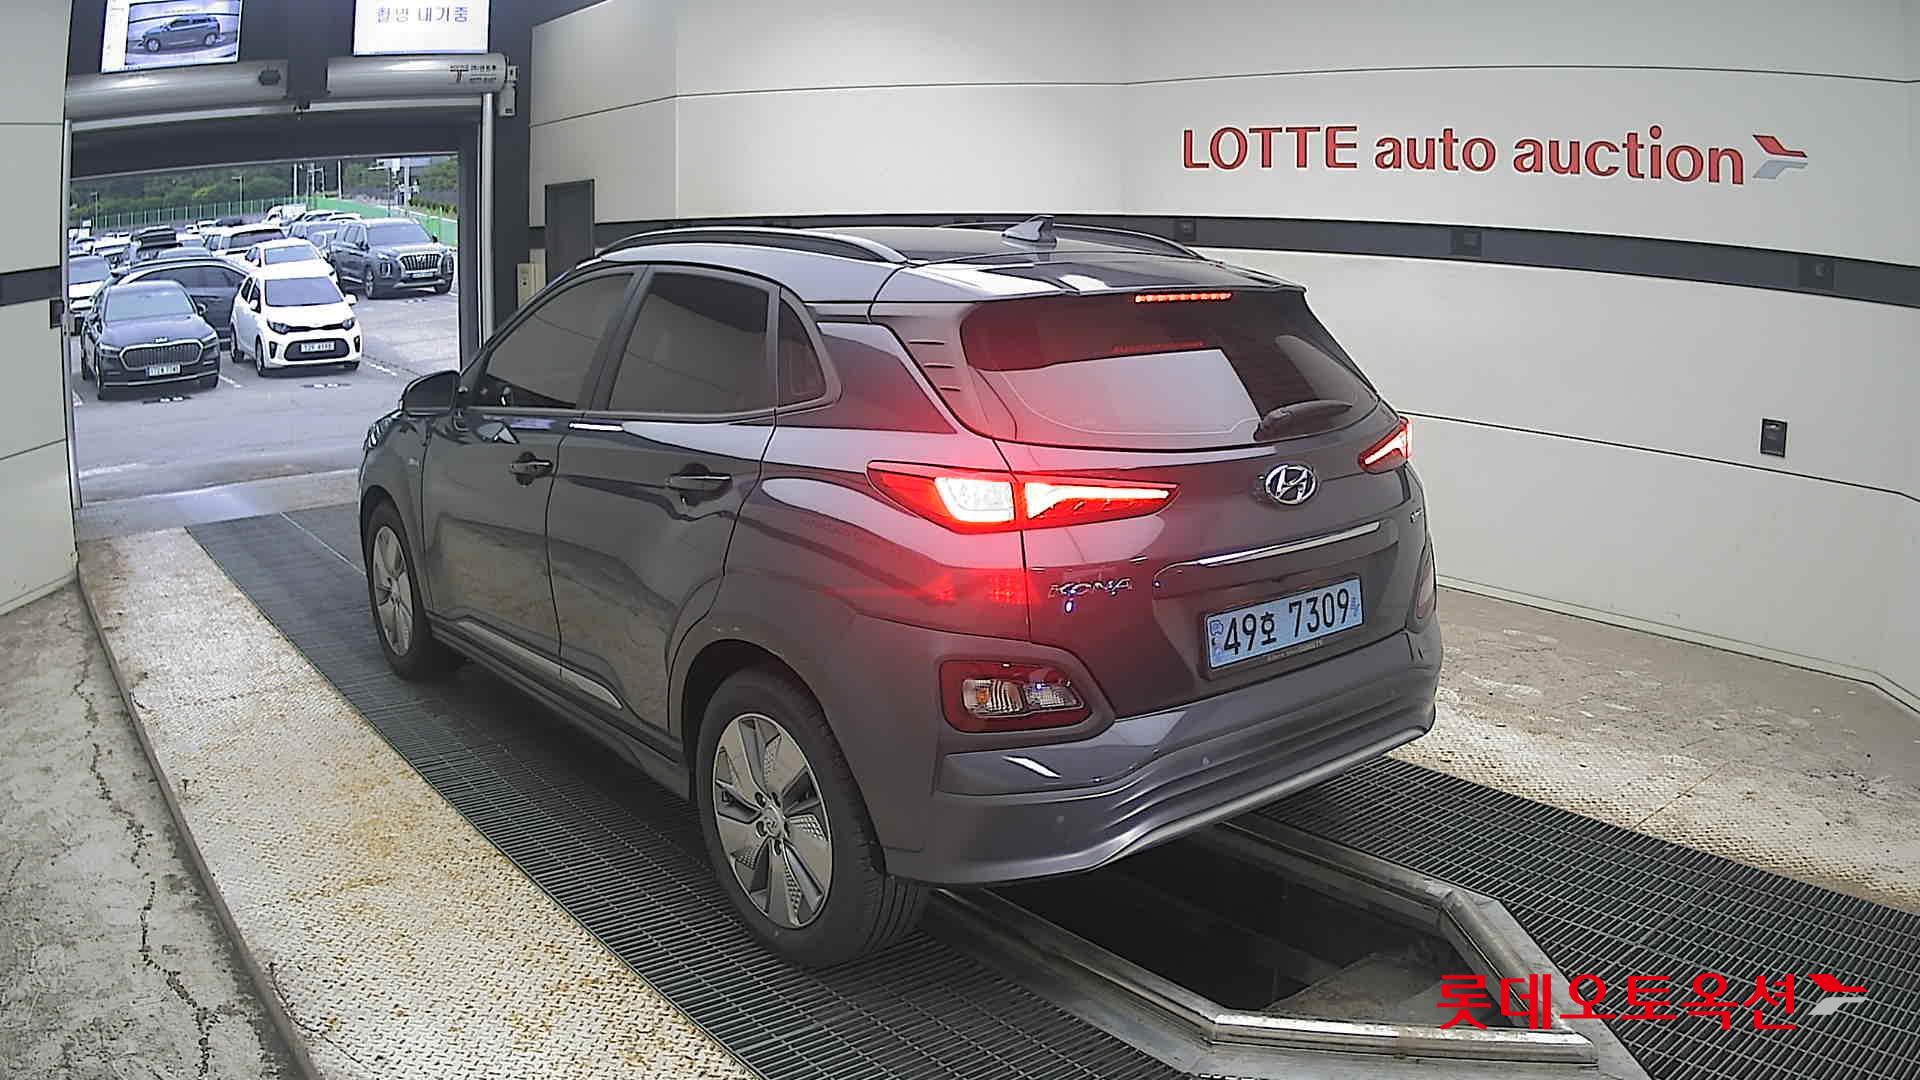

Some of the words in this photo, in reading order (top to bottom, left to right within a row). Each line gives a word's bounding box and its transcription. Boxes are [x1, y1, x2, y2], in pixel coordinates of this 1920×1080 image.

[1183, 126, 1358, 169] LOTTE
[1374, 128, 1497, 171] auto
[1513, 125, 1745, 185] auction
[1048, 577, 1132, 600] KONA
[1224, 612, 1277, 655] 49호
[1288, 588, 1349, 638] 7309
